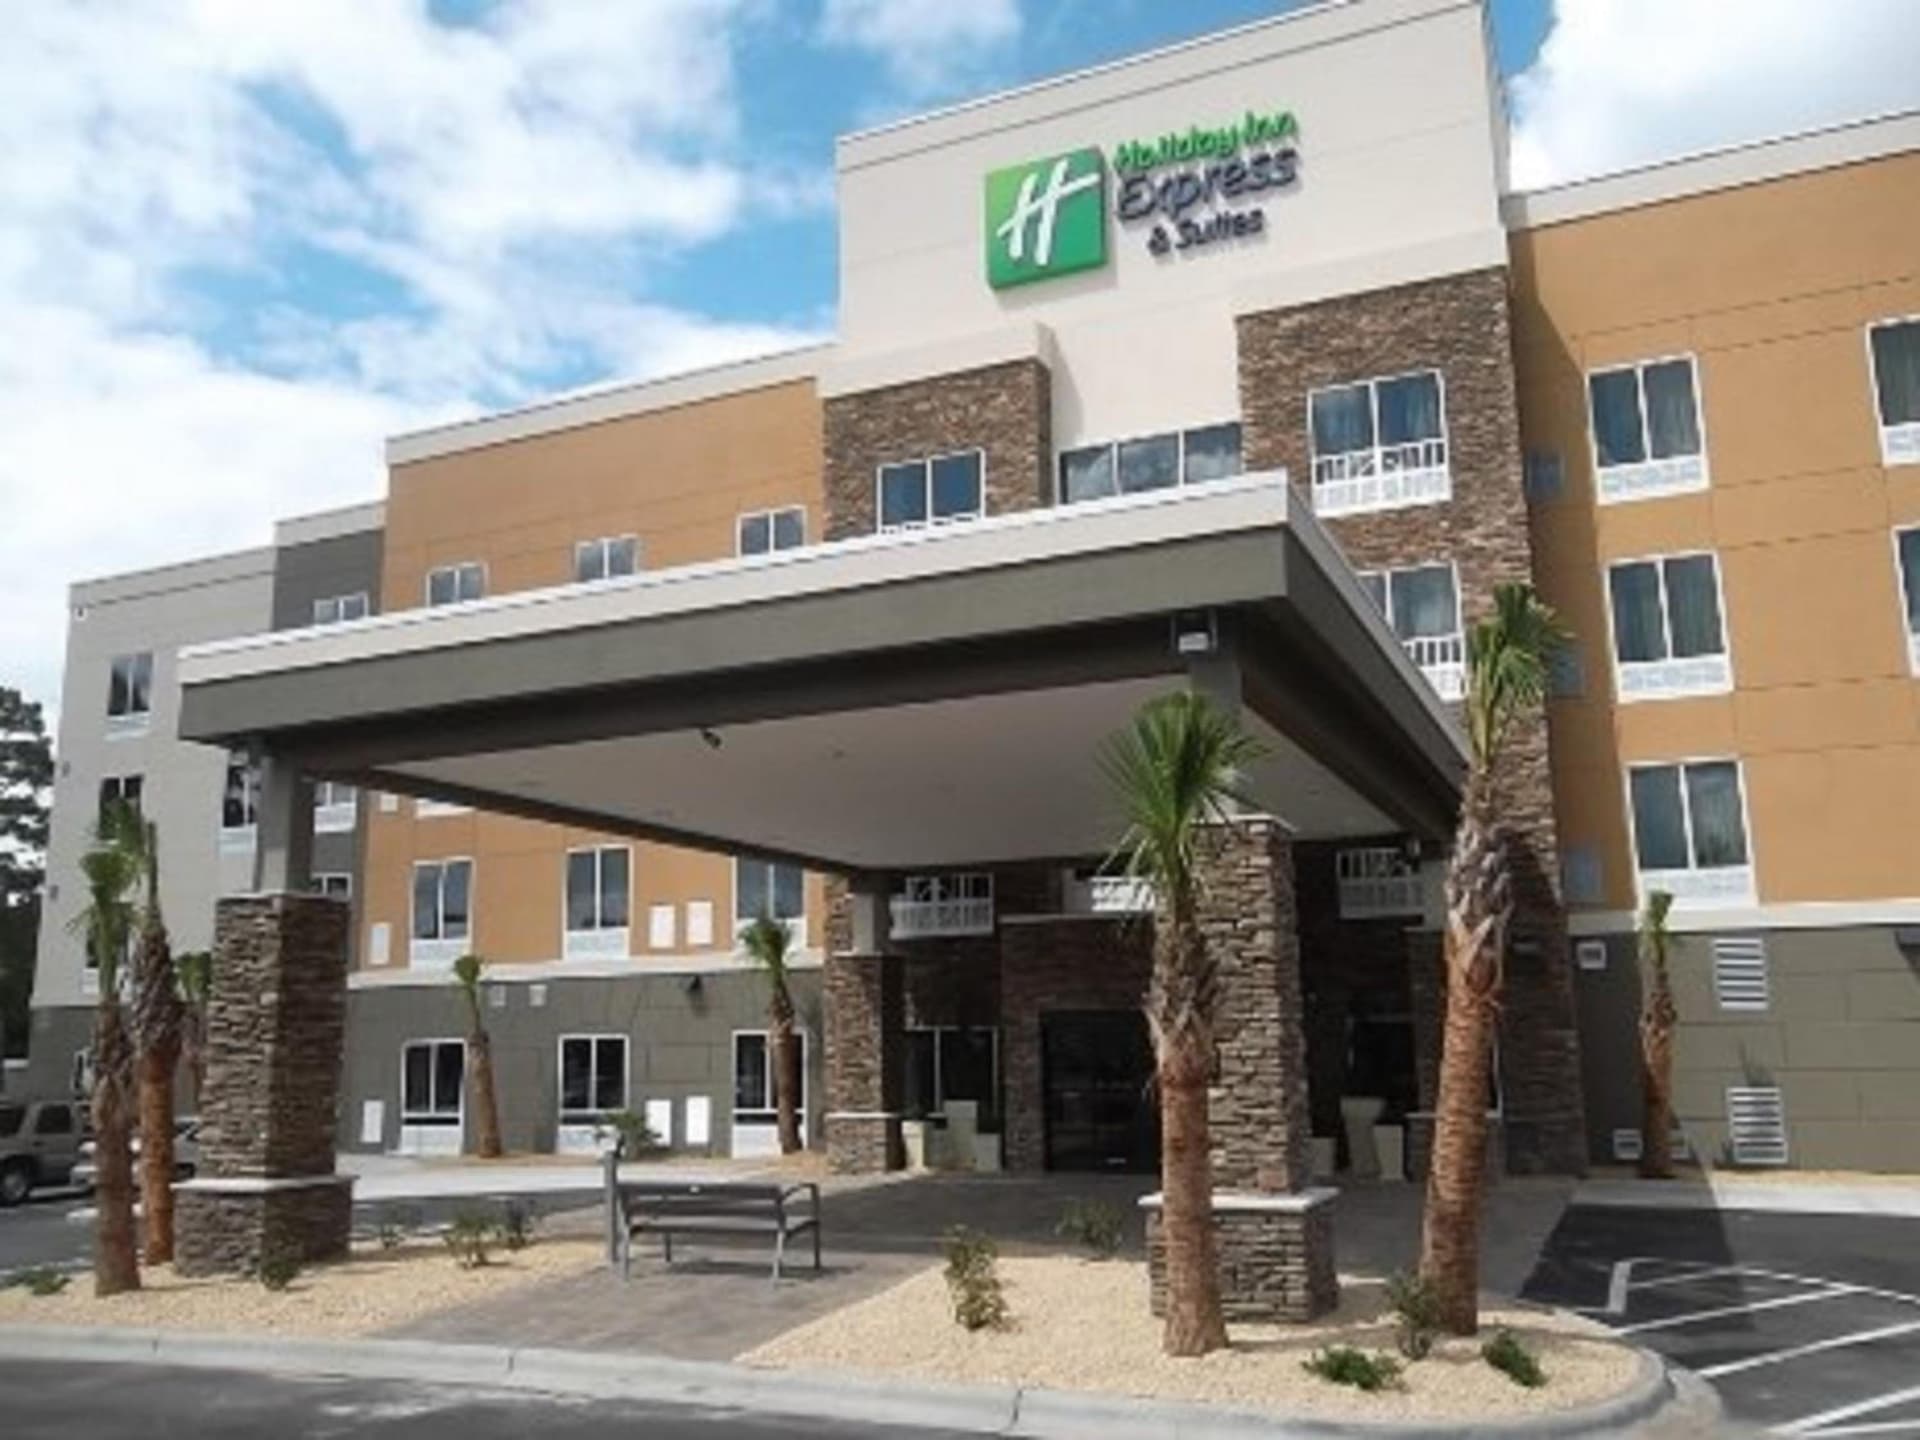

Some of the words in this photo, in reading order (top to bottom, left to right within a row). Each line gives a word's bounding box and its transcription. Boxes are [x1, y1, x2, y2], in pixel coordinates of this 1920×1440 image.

[1115, 124, 1238, 171] Holiday
[1245, 110, 1298, 146] Inn
[1118, 146, 1298, 222] Express
[1147, 224, 1170, 257] &
[1175, 208, 1265, 249] Suites
